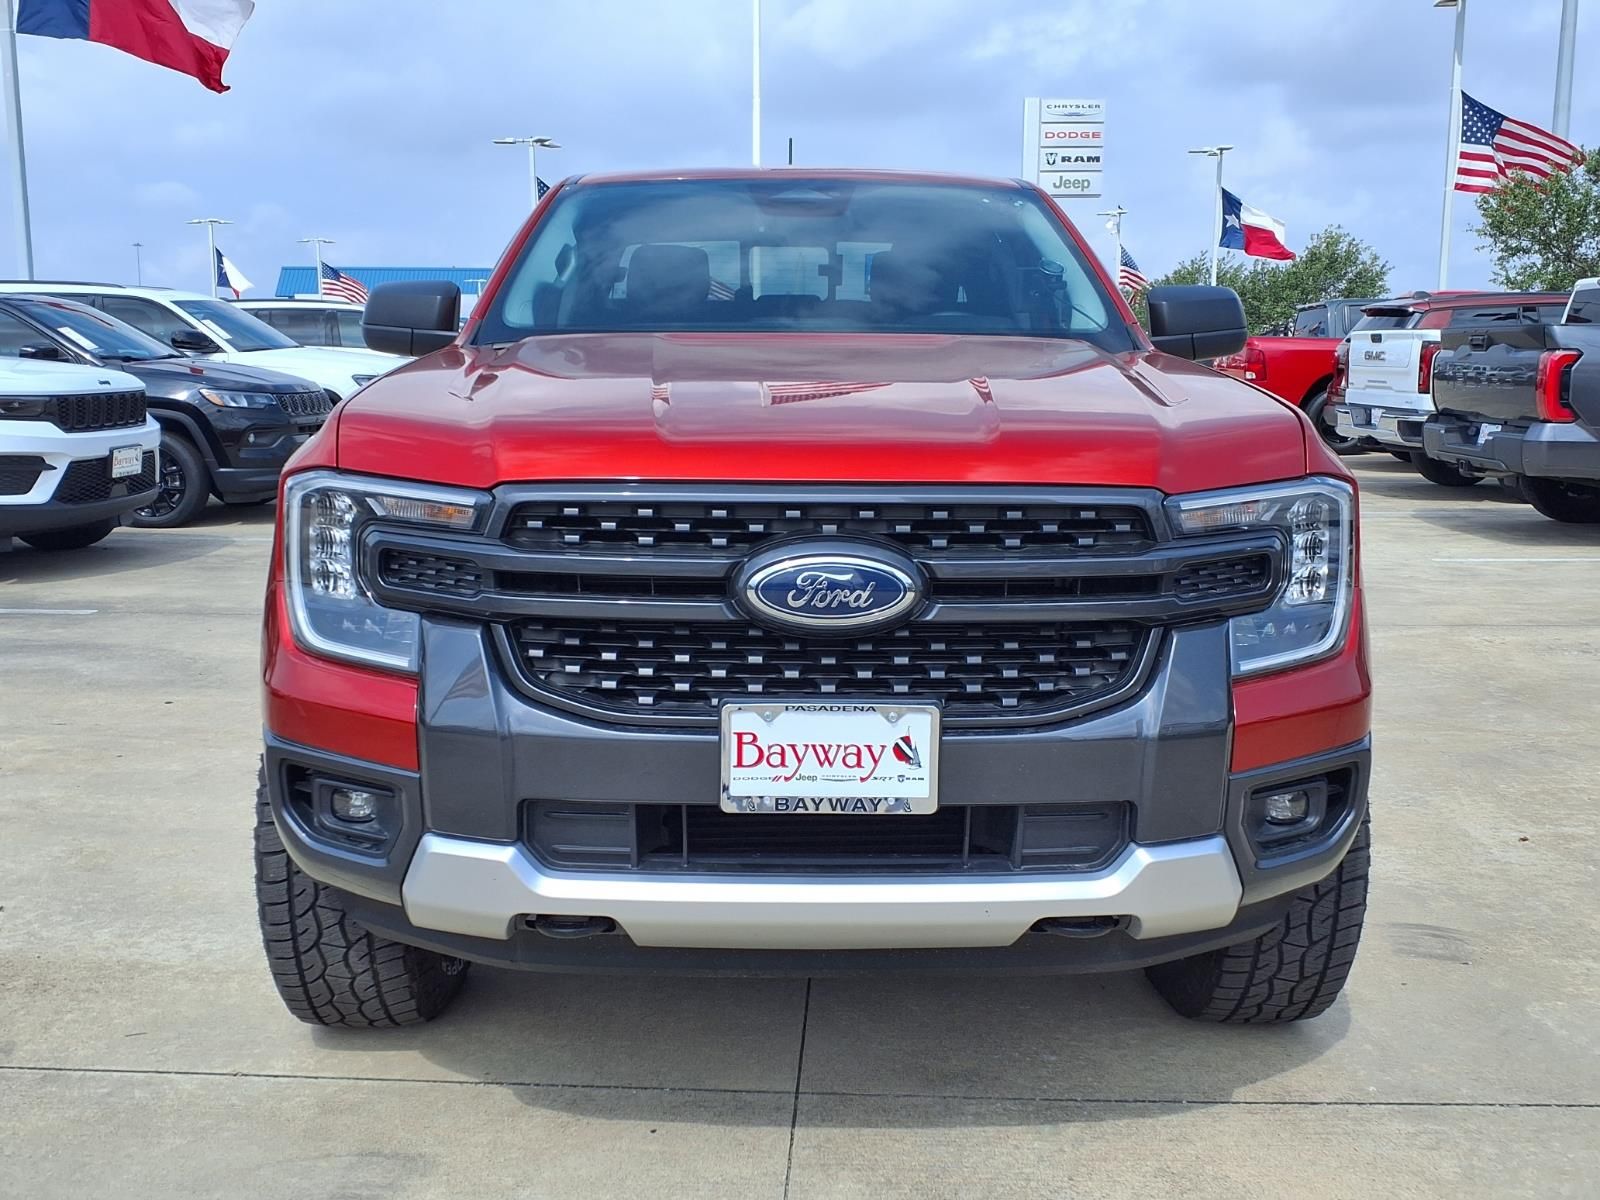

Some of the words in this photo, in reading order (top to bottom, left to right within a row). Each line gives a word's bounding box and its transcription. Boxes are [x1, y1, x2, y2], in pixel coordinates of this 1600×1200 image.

[1044, 131, 1102, 139] DODGE
[1060, 155, 1101, 163] RAM
[1052, 175, 1091, 192] Jeep
[1364, 350, 1386, 361] GMC
[786, 571, 877, 609] Ford
[785, 704, 877, 713] PASADENA
[732, 731, 888, 784] Bayway
[795, 773, 818, 783] Jeep
[774, 797, 883, 813] BAYWAY
